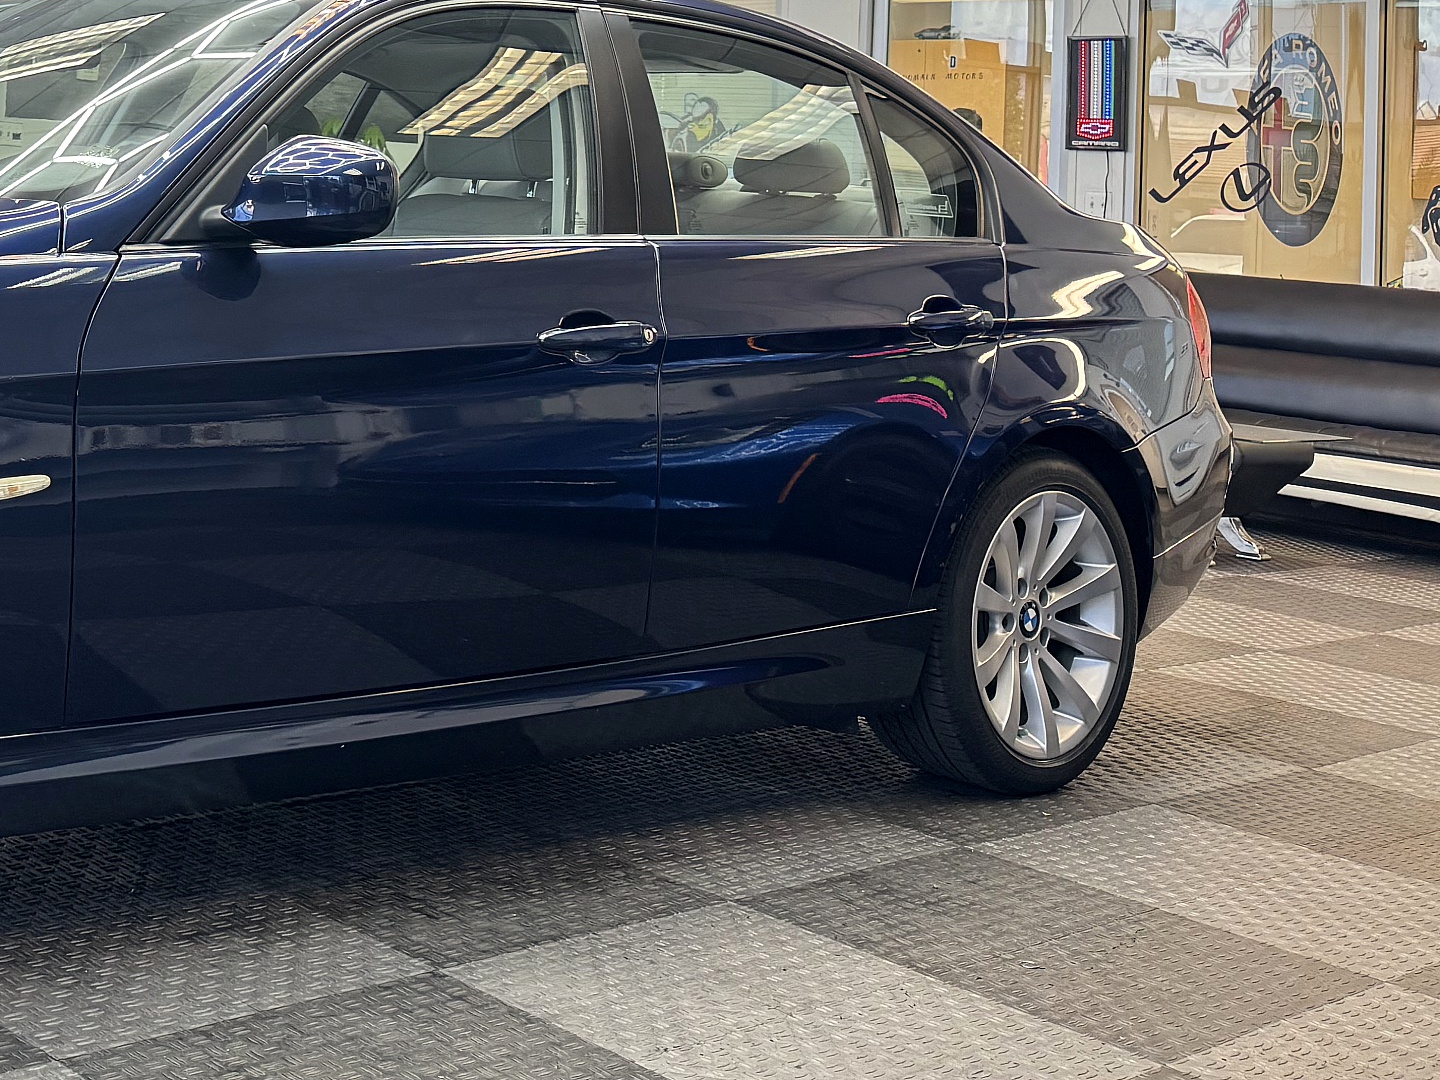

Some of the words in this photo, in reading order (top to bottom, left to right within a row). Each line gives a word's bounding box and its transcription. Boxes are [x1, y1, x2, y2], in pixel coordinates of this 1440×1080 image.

[944, 71, 984, 81] MOTORS
[1291, 39, 1341, 146] ROMEO
[1148, 80, 1282, 203] LEXUS
